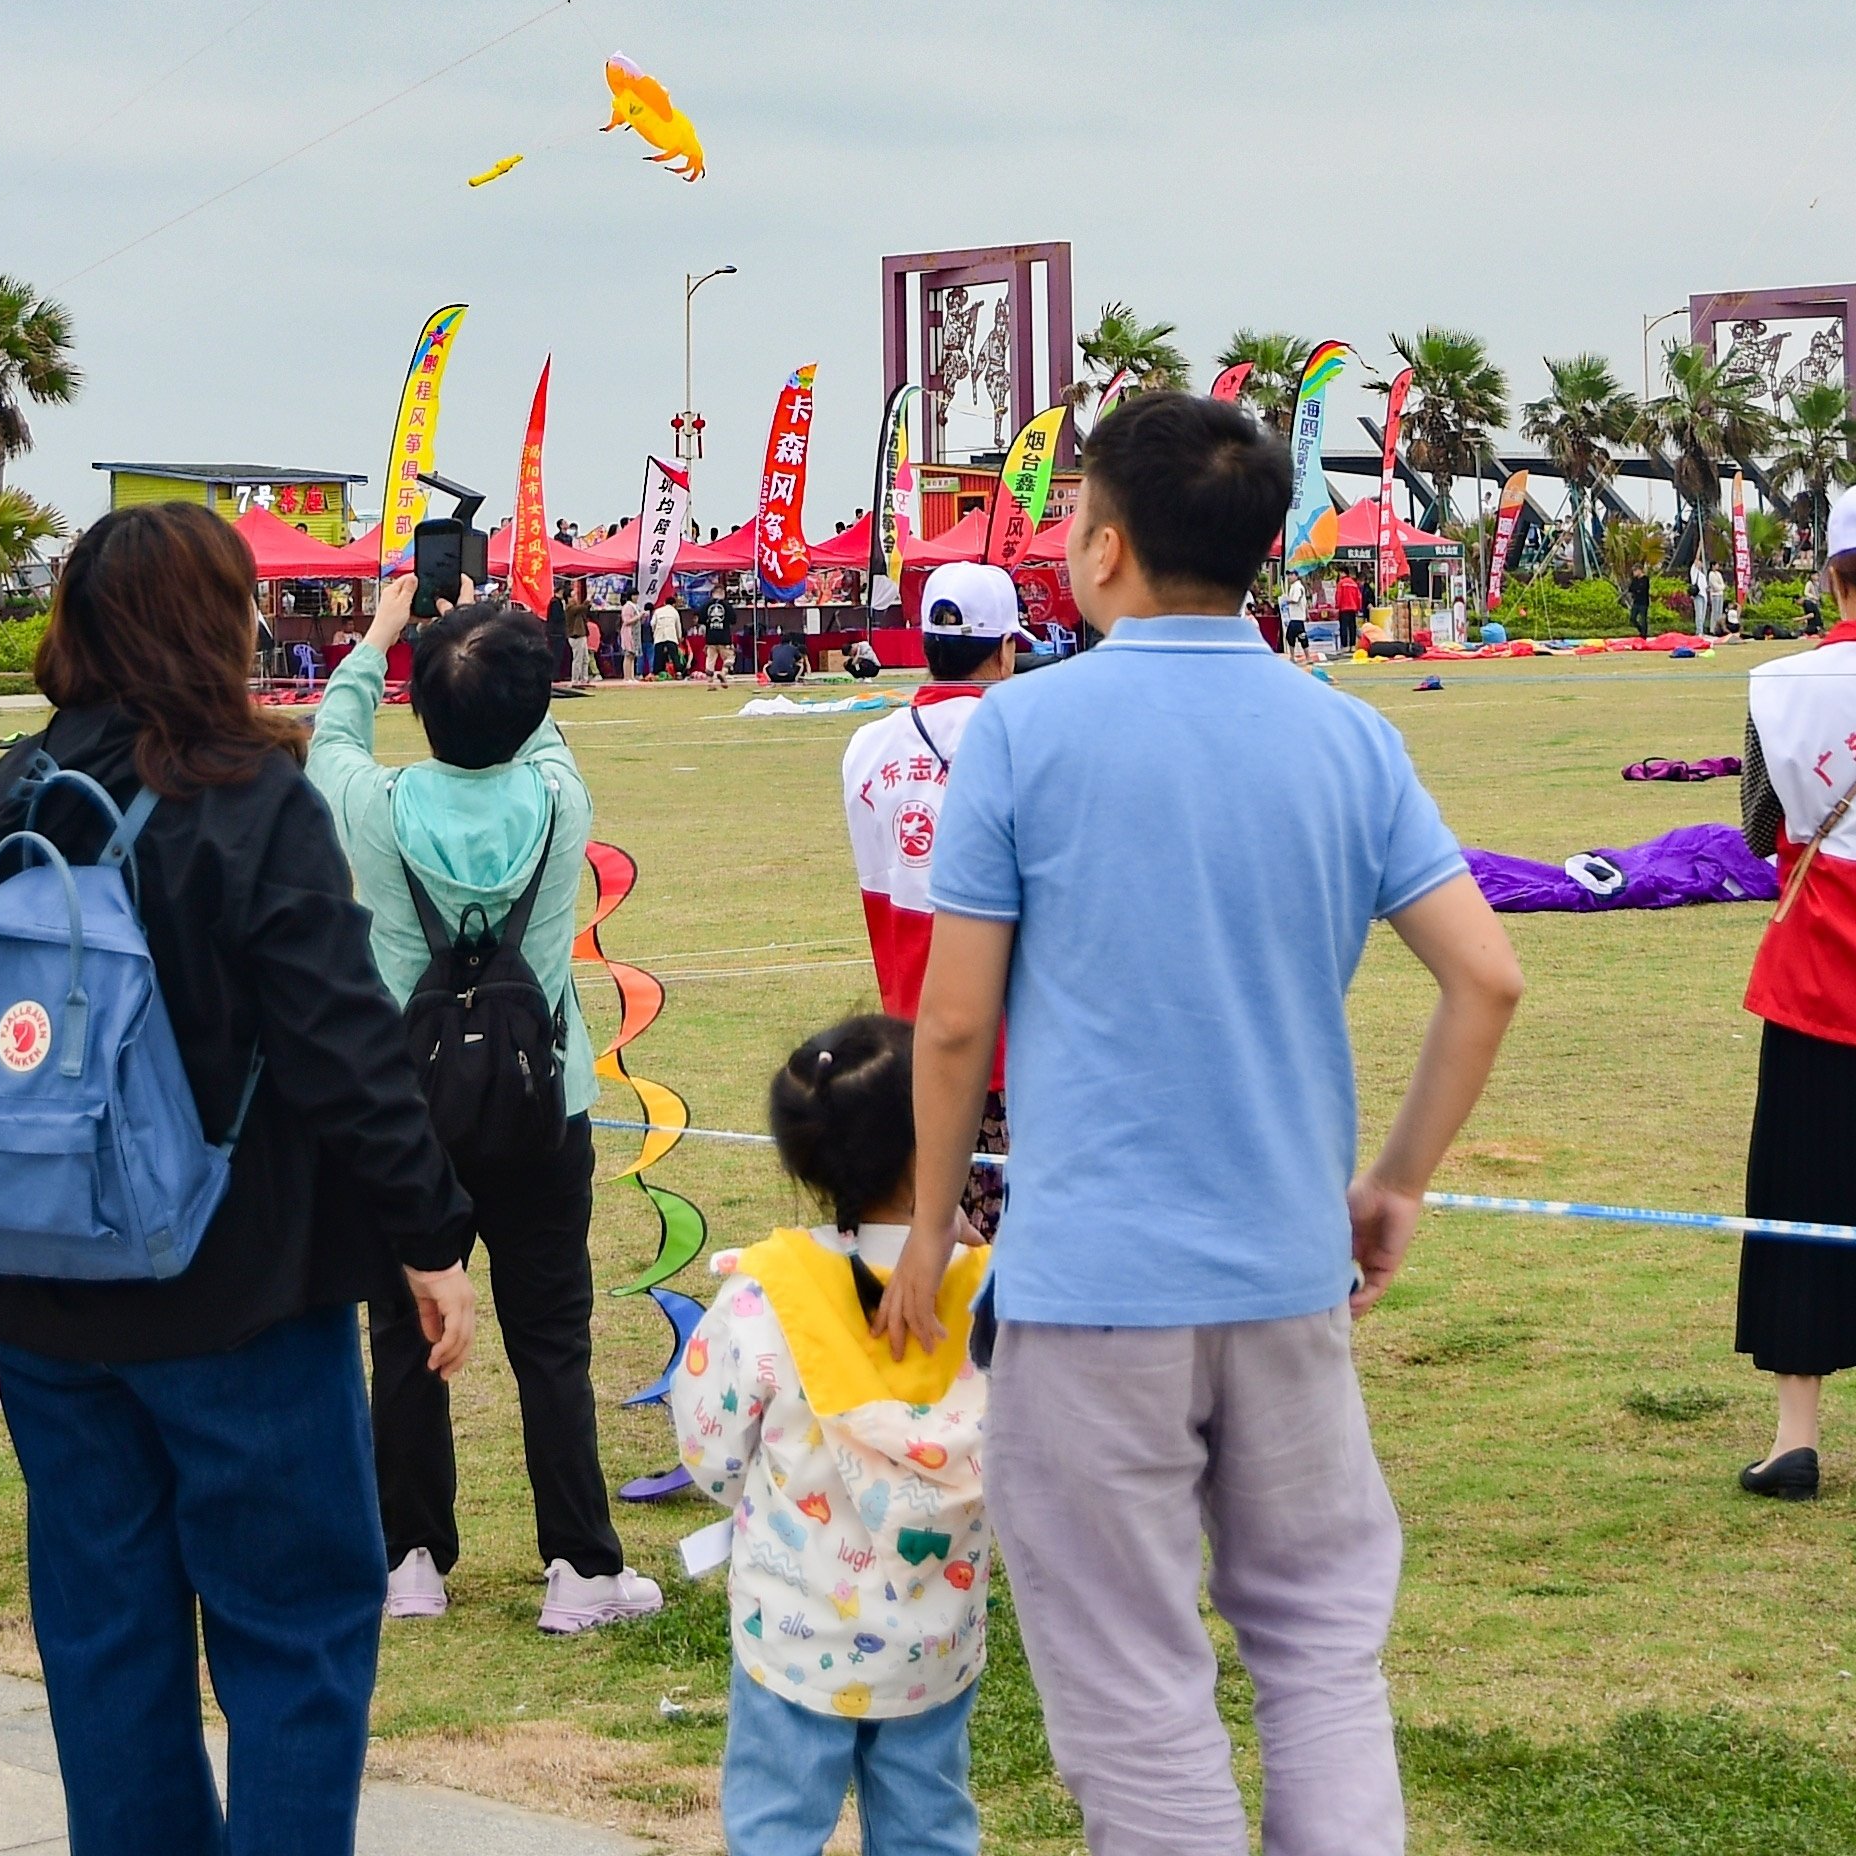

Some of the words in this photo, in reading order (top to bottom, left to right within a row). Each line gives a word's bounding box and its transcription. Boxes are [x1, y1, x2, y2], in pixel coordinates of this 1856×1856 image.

[395, 354, 440, 535] 鹏程风筝俱乐部
[1001, 428, 1046, 569] 烟台鑫宇风筝
